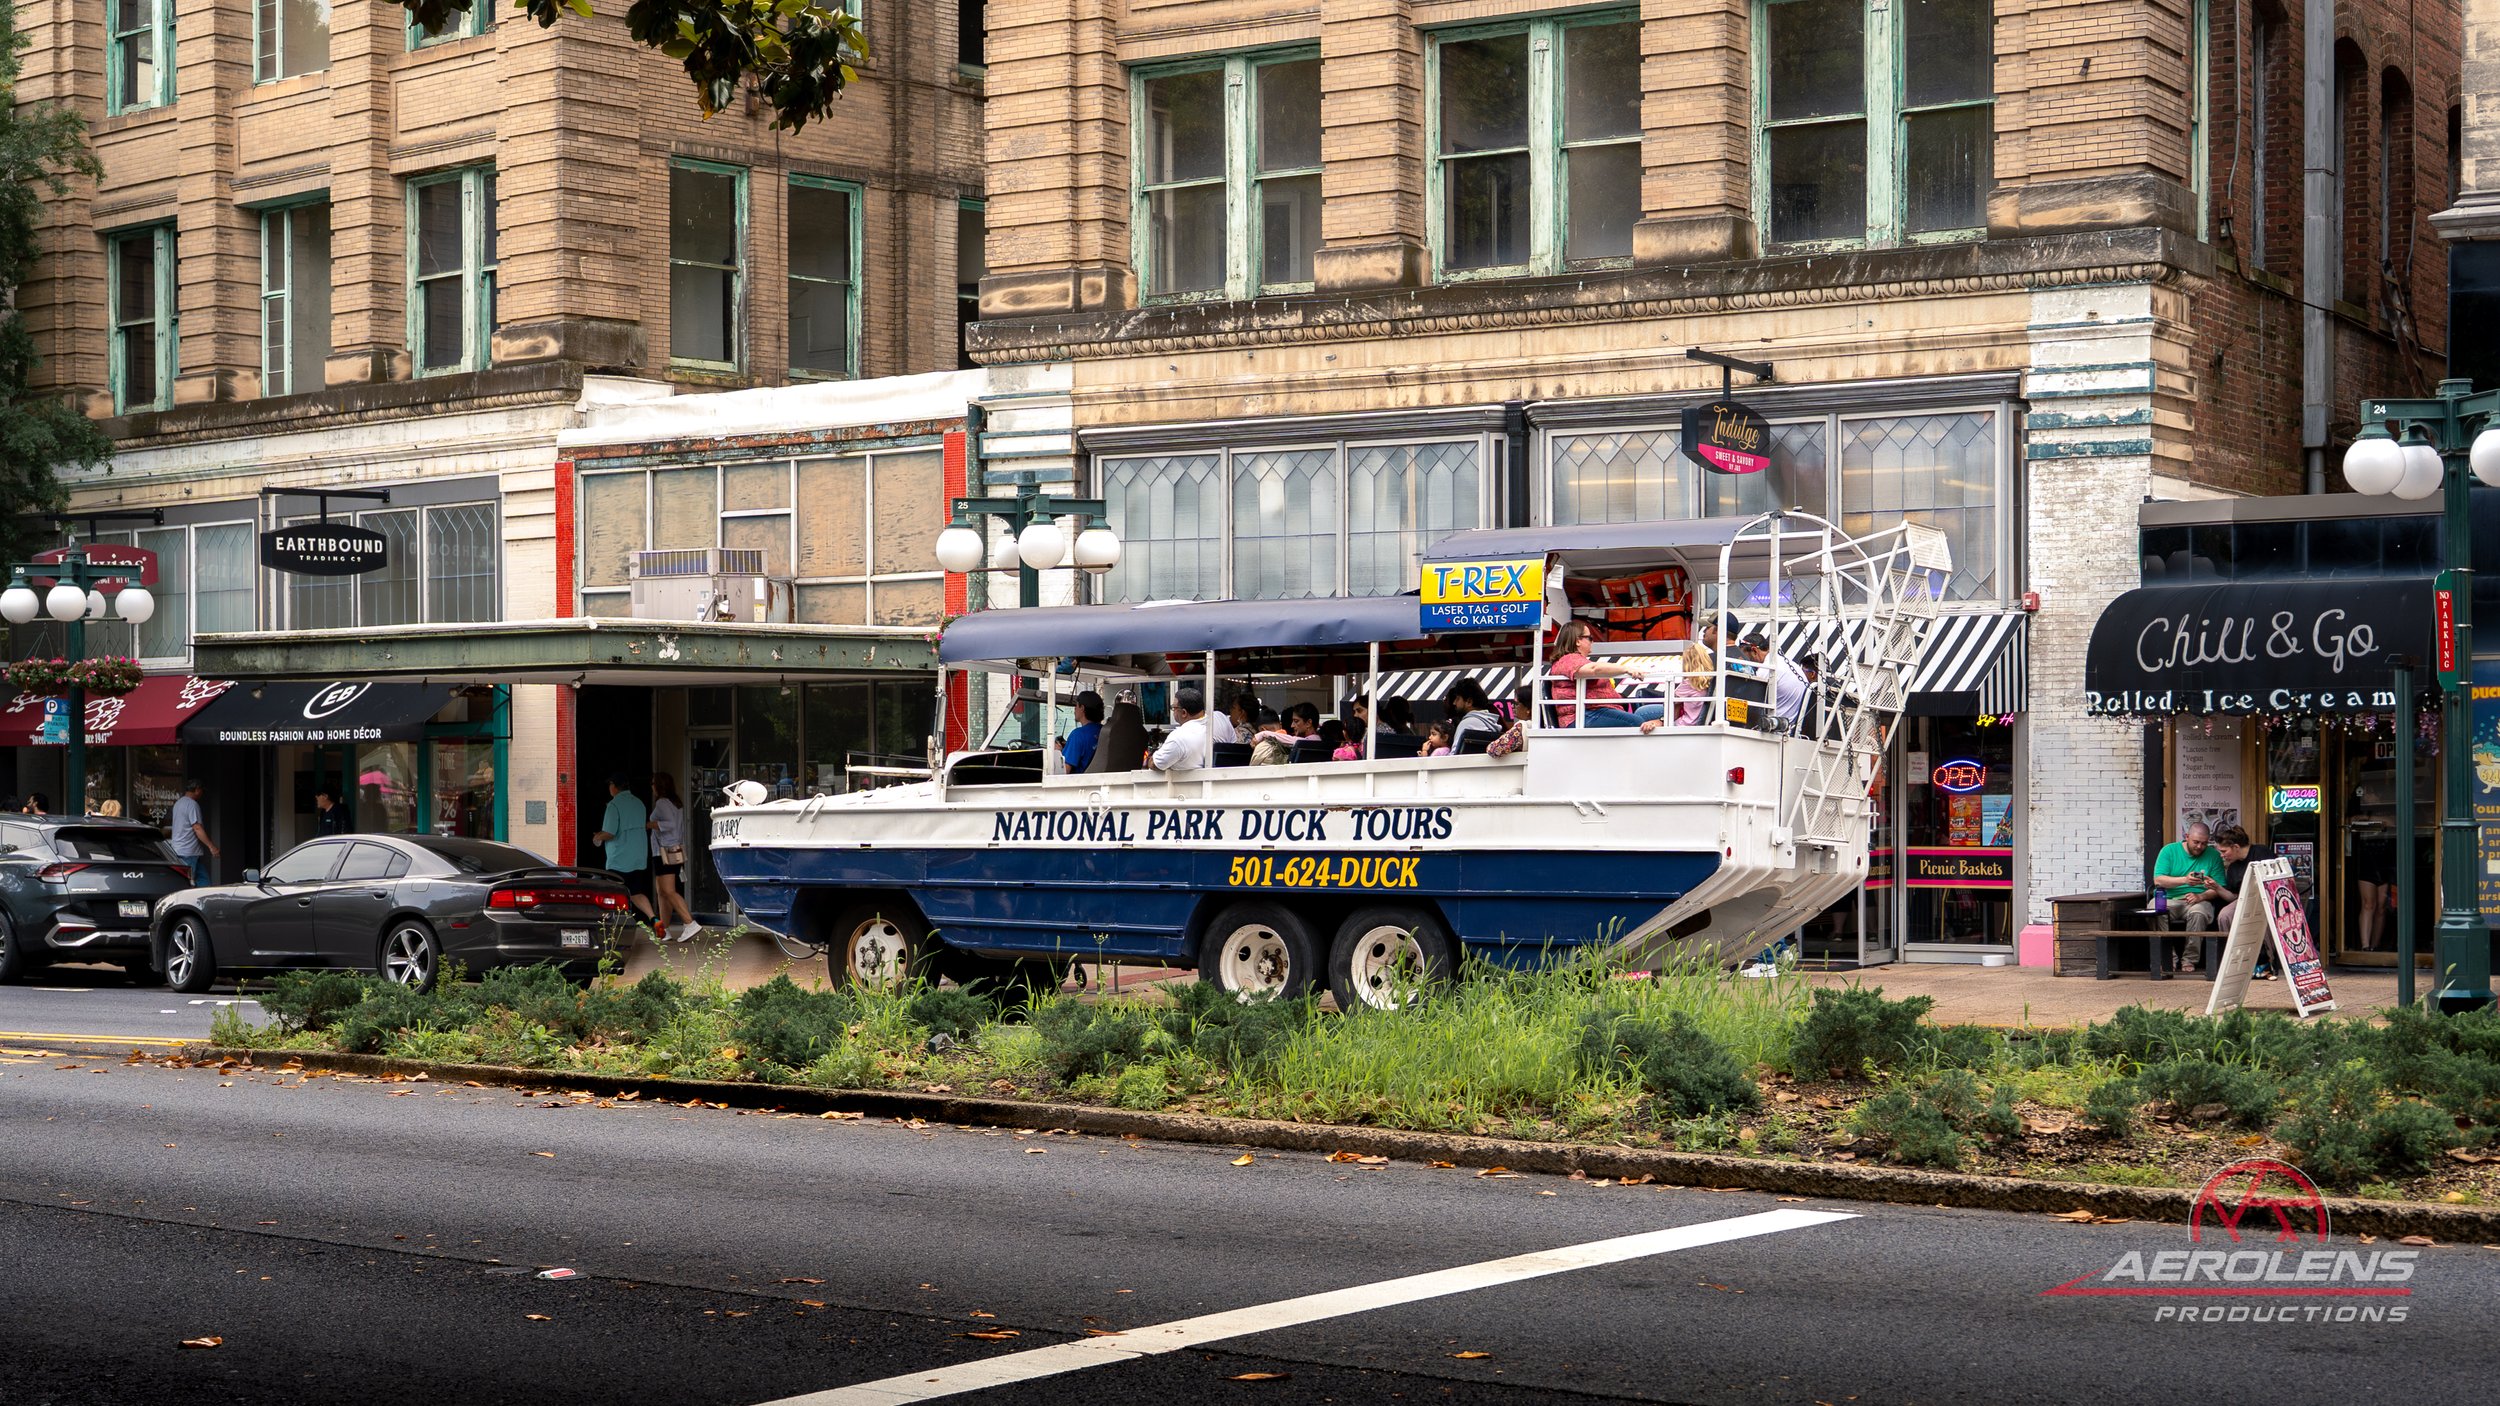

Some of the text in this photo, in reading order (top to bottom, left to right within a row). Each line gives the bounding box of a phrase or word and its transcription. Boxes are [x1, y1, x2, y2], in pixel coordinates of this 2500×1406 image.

[2373, 404, 2387, 414] 24
[1711, 405, 1760, 450] Indulge
[1715, 451, 1754, 466] SWEET & SAVORY
[958, 502, 969, 510] 25
[275, 536, 384, 554] EARTHBOUND
[15, 566, 25, 574] 26
[1433, 563, 1528, 598] T-REX
[2439, 591, 2450, 600] NO
[1432, 603, 1530, 616] LASER TAG GOLF
[1452, 614, 1508, 625] GO KARTS
[2136, 608, 2380, 674] Chill & Go
[2442, 600, 2450, 668] PARKING
[320, 685, 358, 708] EB
[2086, 688, 2398, 712] Rolled Ice Cream
[220, 726, 382, 742] BOUNDLESS FASHION AND HOME DÉCOR
[2377, 743, 2396, 758] OP
[1933, 766, 1986, 786] OPEN
[2272, 790, 2318, 812] Open
[2287, 789, 2318, 798] we are
[992, 806, 1454, 842] NATIONAL PARK DUCK TOURS
[1228, 856, 1422, 888] 501-624-DUCK
[1920, 859, 2003, 876] Picnic Baskets
